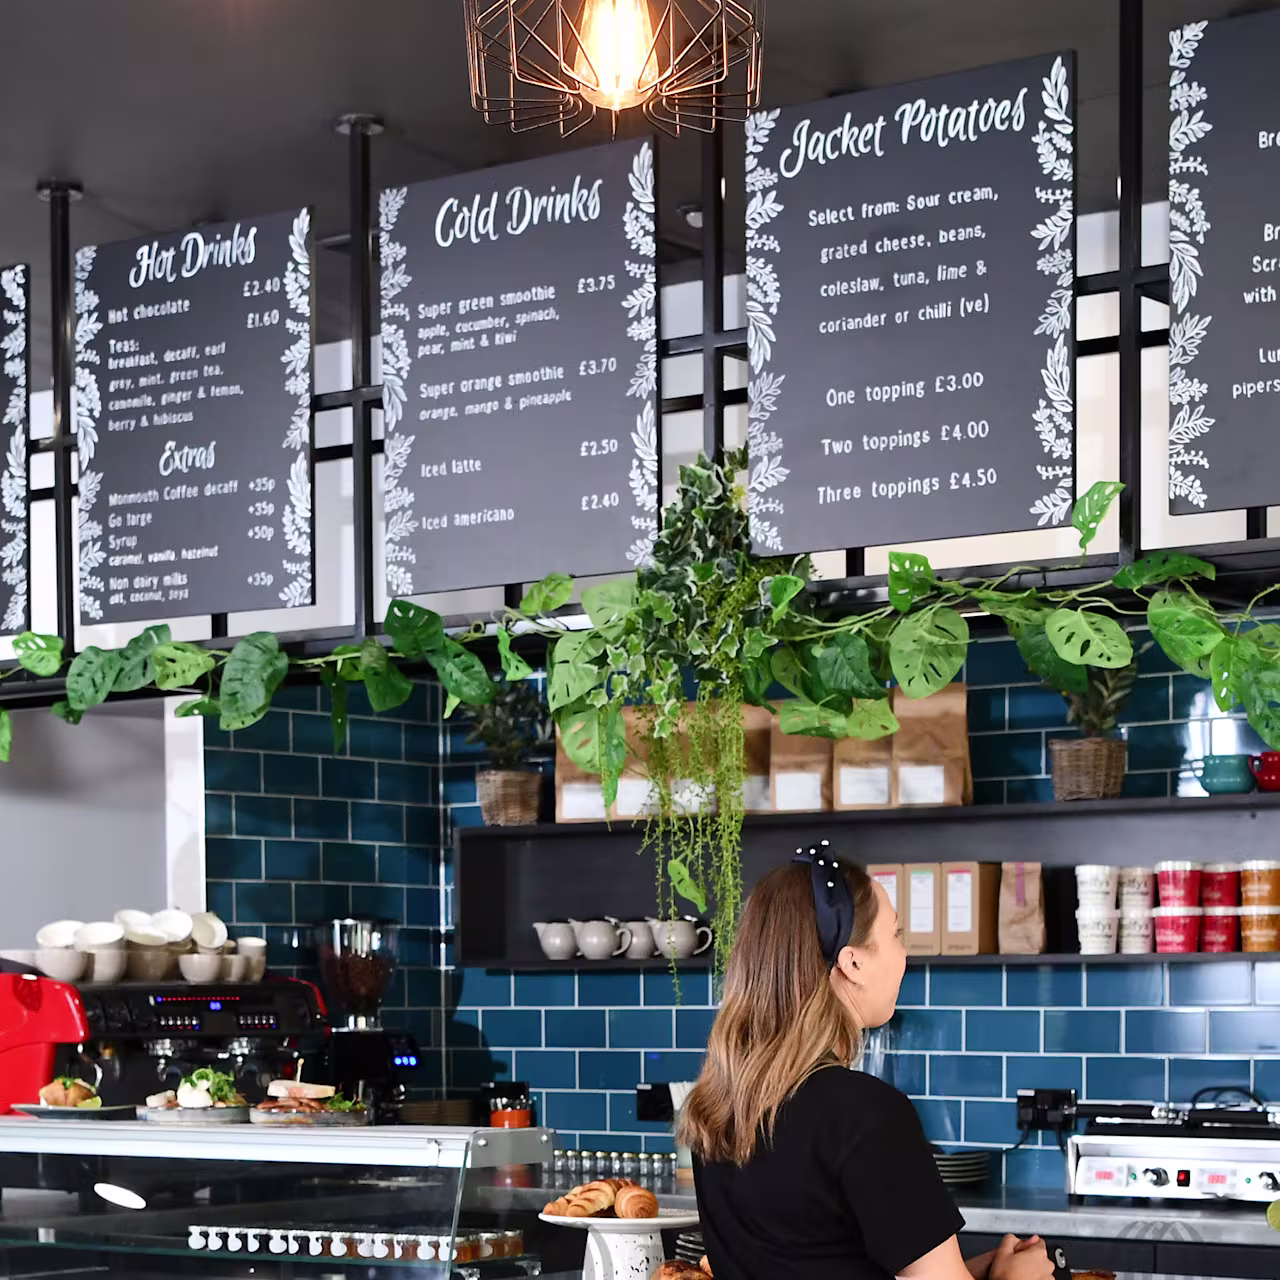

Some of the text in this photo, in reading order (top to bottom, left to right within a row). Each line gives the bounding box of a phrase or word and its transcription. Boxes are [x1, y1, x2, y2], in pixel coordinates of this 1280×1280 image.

[780, 88, 1027, 178] Jacket Potatoes
[435, 176, 602, 247] Cold Drinks
[809, 187, 998, 226] Select from: Sour cream,
[129, 223, 257, 287] Hot Drinks
[821, 225, 985, 263] grated cheese, beans,
[820, 260, 986, 297] coleslaw, tuna, lime &
[1244, 286, 1276, 303] with
[108, 277, 280, 323] Hot chocolate £2.40
[418, 275, 615, 319] Super green smoothie £3.75
[819, 293, 989, 333] coriander or chilli (ve)
[109, 309, 279, 354] Teas: £1.60
[418, 307, 559, 340] apple, cucumber, spinach,
[205, 342, 225, 355] earl
[418, 330, 517, 358] pear, mint & kiwi
[170, 370, 198, 384] green
[197, 386, 206, 398] &
[420, 358, 616, 399] Super orange smoothie £3.70
[826, 372, 983, 406] One topping £3.00
[1233, 379, 1280, 399] pipers
[465, 401, 499, 414] mango
[504, 397, 512, 410] &
[520, 389, 571, 410] pineapple
[108, 412, 193, 431] berry & hibiscus
[821, 420, 989, 455] Two toppings £4.00
[159, 441, 216, 476] Extras
[421, 439, 618, 477] Iced latte £2.50
[109, 477, 275, 506] Monmouth Coffee decaff +35p
[818, 468, 996, 504] Three toppings £4.50
[108, 501, 274, 528] Go large +35p
[422, 492, 619, 530] Iced americano £2.40
[109, 525, 274, 550] Syrup +50p
[181, 546, 218, 559] hazelnut
[110, 572, 273, 590] Non dairy milks +35p
[169, 589, 188, 600] soya
